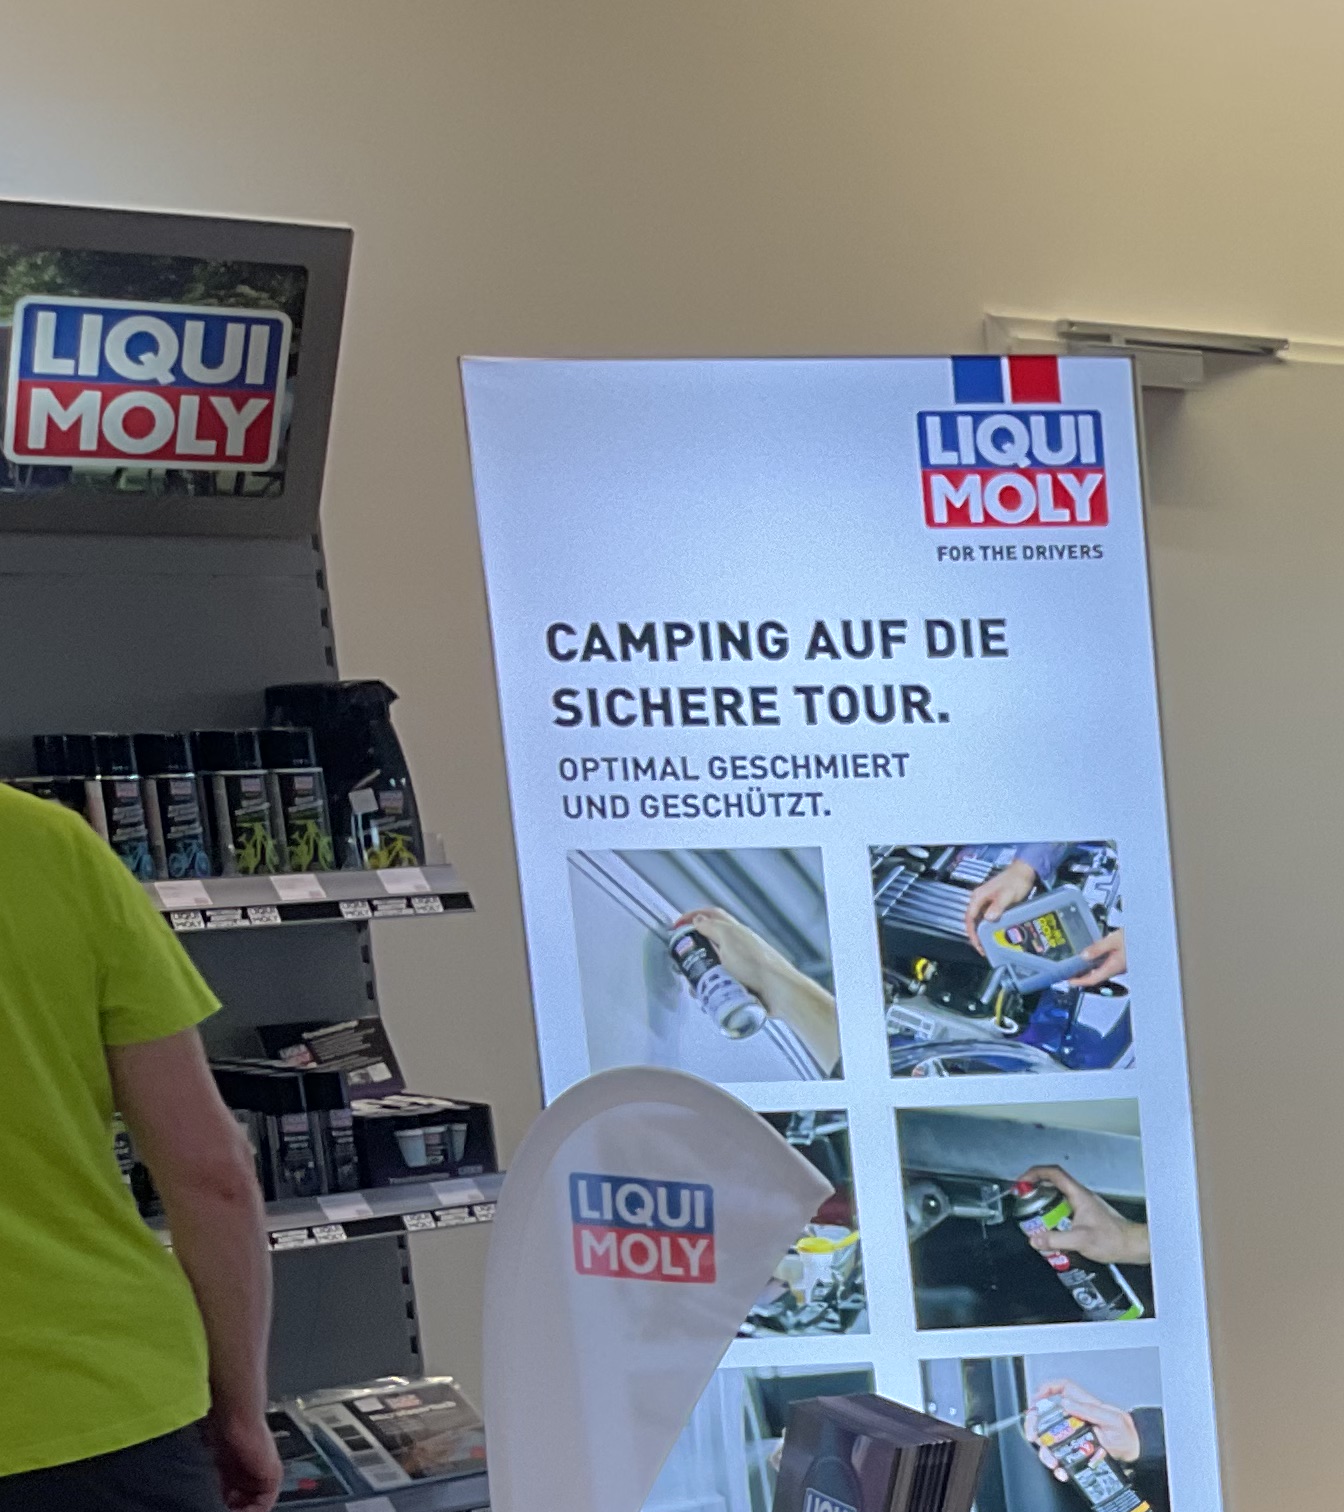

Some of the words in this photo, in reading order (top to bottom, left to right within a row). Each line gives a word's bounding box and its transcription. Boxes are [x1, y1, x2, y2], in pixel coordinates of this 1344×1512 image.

[32, 310, 271, 386] LIQUI
[26, 387, 270, 457] MOLY
[926, 412, 1097, 470] LIQUI
[931, 469, 1104, 526] MOLY
[937, 545, 975, 561] FOR
[980, 545, 1018, 561] THE
[1022, 544, 1104, 561] DRIVERS
[545, 620, 790, 663] CAMPING
[804, 619, 909, 661] AUF
[926, 618, 1010, 659] DIE
[552, 686, 780, 727] SICHERE
[794, 685, 951, 726] TOUR.
[559, 756, 699, 782] OPTIMAL
[708, 753, 911, 780] GESCHMIERT
[562, 794, 630, 820] UND
[639, 788, 832, 819] GESCHÜTZT.
[577, 1179, 706, 1229] LIQUI
[580, 1231, 711, 1278] MOLY
